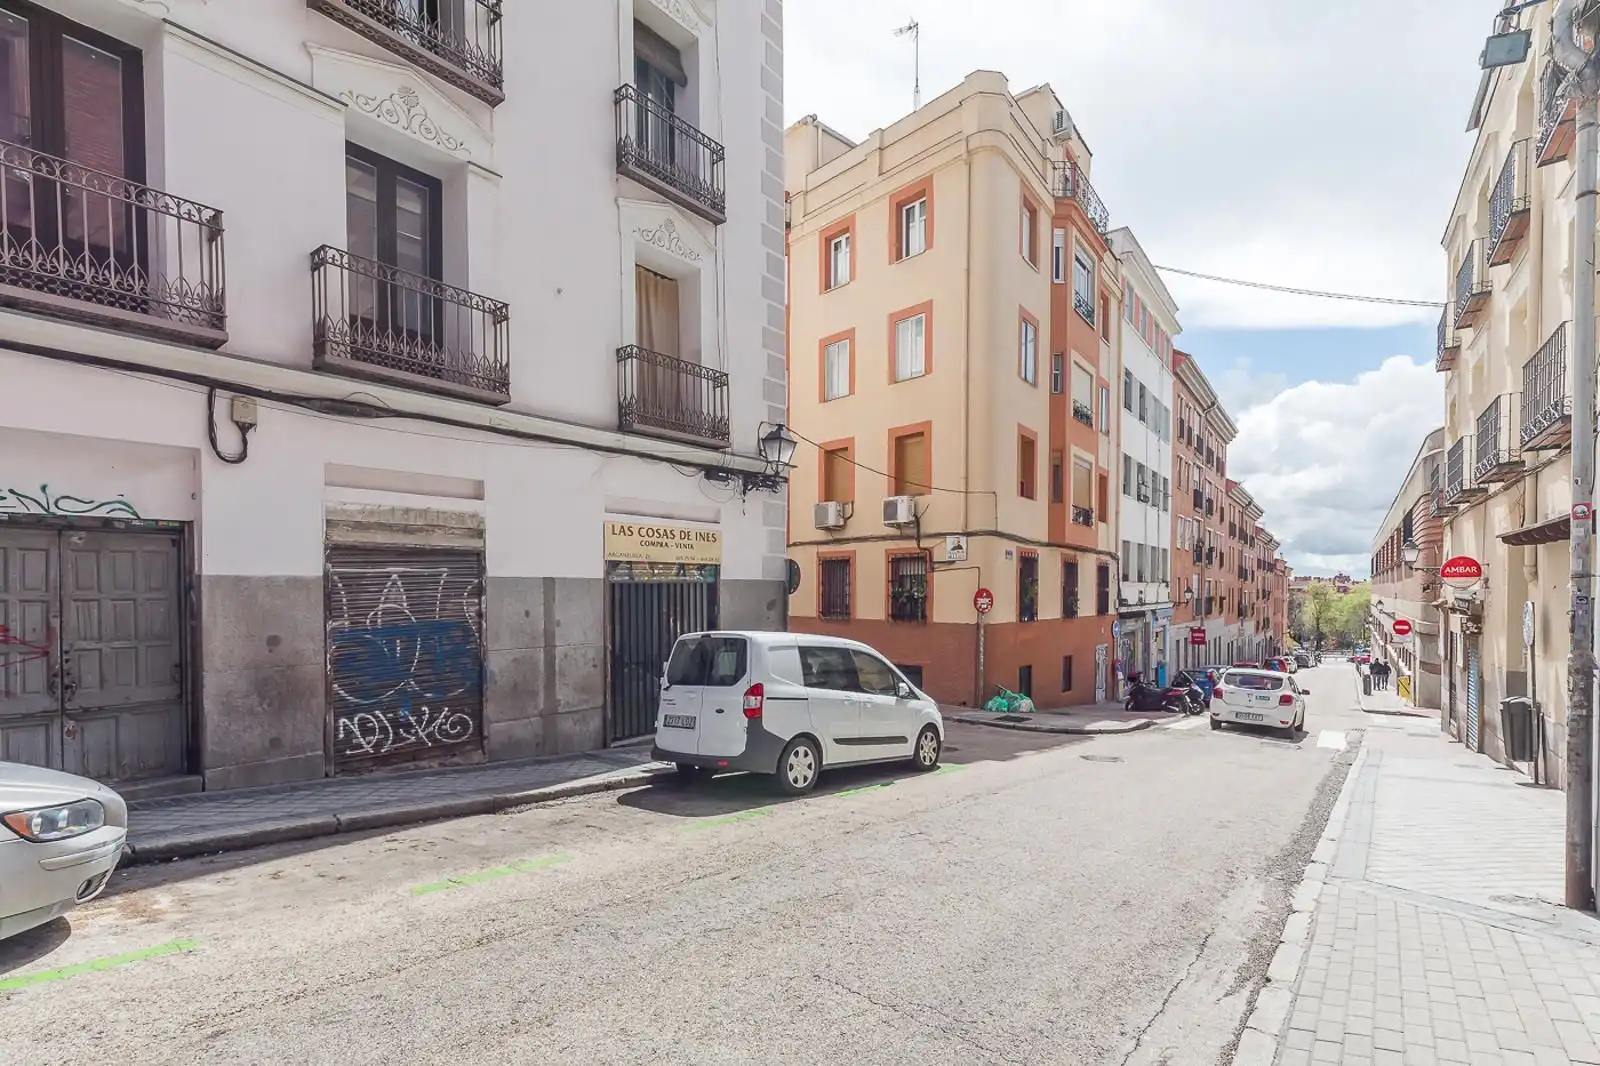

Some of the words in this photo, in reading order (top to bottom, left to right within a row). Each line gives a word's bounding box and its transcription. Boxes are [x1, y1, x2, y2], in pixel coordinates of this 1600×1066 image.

[611, 524, 634, 537] LAS
[637, 527, 676, 540] COSAS
[679, 530, 693, 541] DE
[695, 532, 717, 543] INES
[640, 540, 669, 549] COMPRA
[674, 542, 695, 550] VENTA
